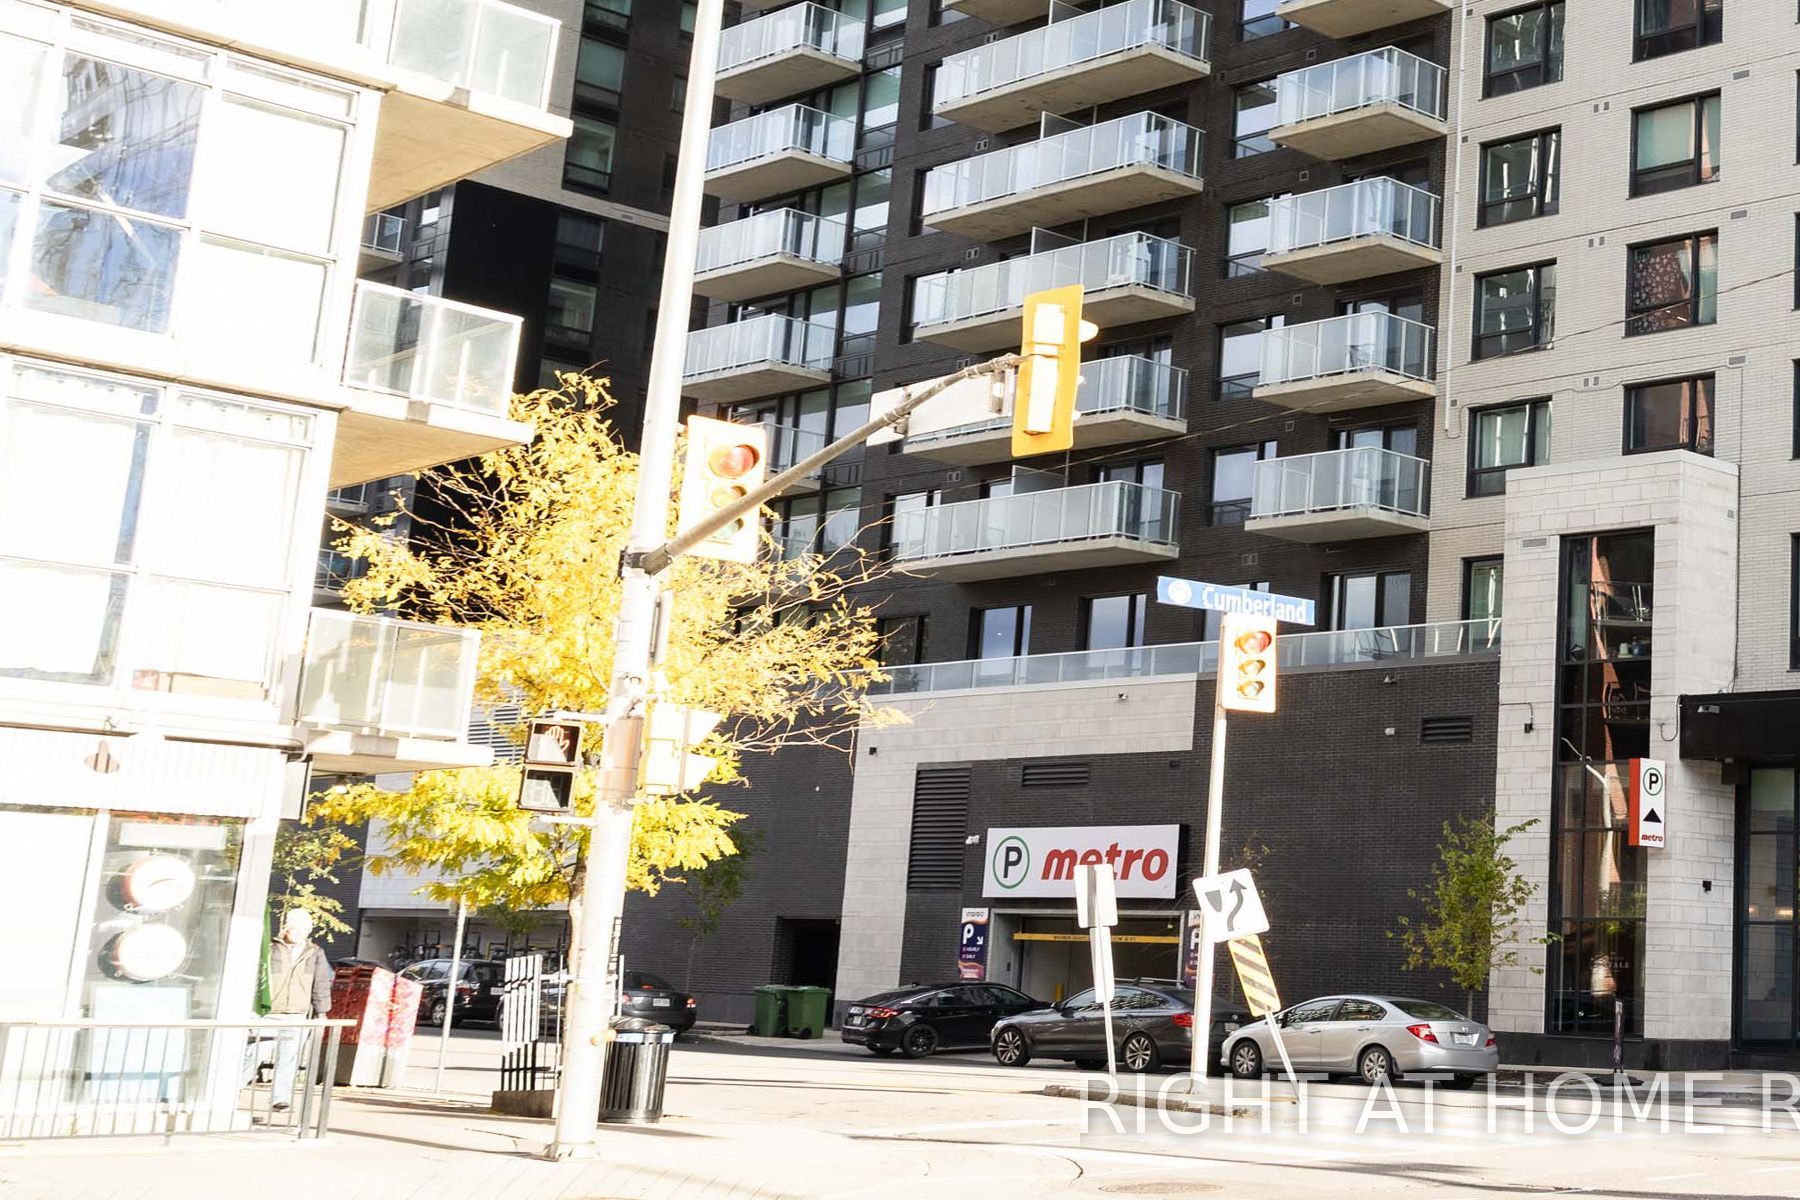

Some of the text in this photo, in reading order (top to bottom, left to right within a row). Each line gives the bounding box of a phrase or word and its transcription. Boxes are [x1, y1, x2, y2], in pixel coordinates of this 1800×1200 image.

[1202, 586, 1306, 622] Cumberland
[1649, 773, 1659, 790] P
[1641, 834, 1663, 842] metro
[1003, 842, 1169, 881] P metro
